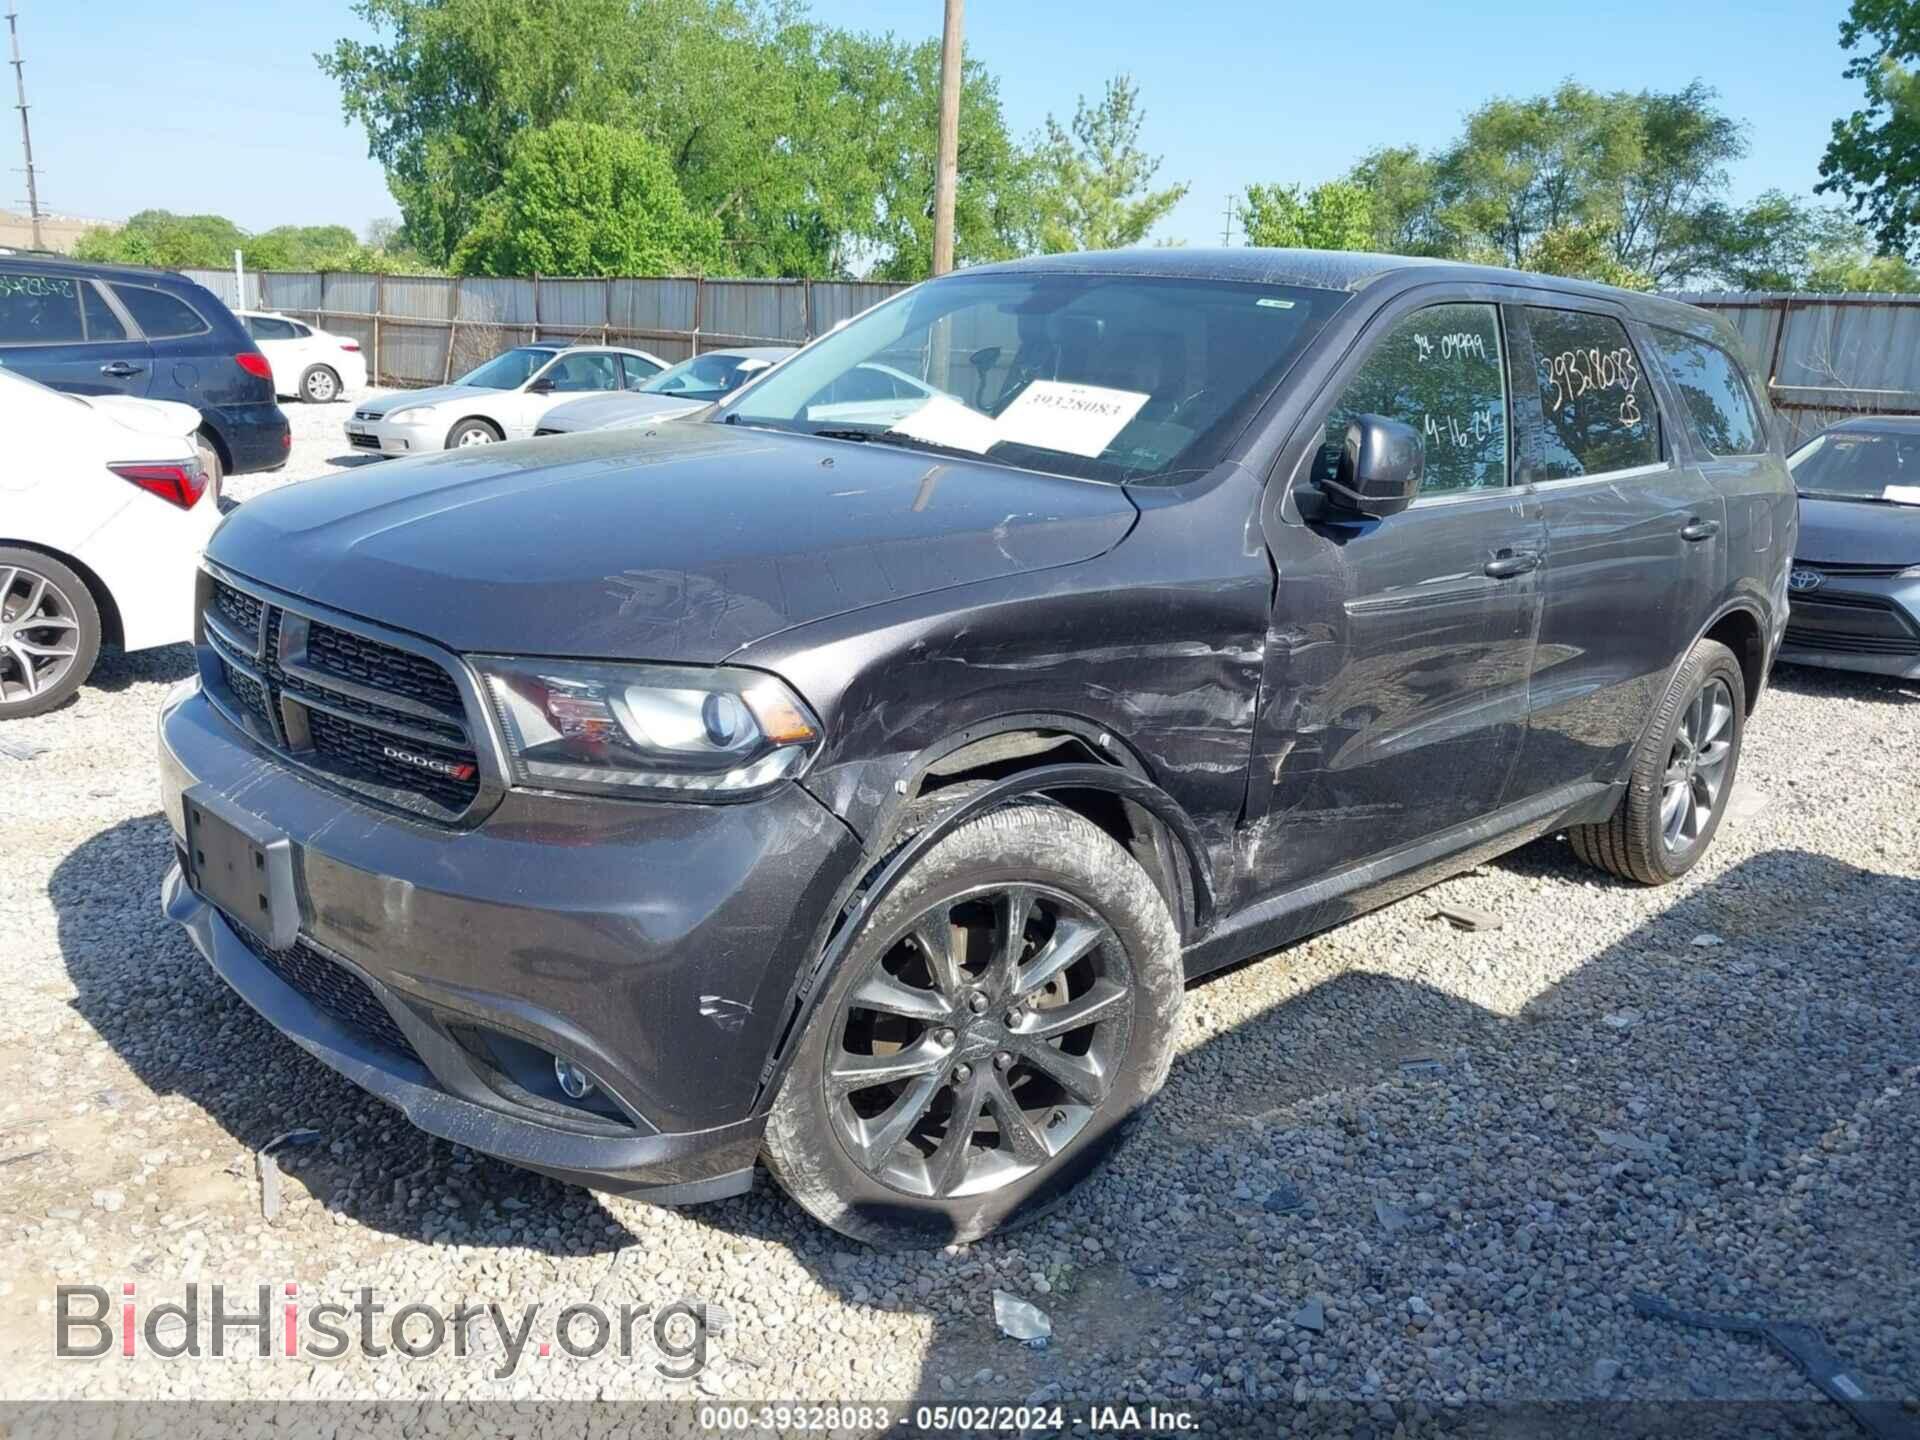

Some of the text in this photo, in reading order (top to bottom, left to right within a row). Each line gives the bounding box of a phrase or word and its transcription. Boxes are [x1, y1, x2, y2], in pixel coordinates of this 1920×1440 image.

[1540, 347, 1638, 412] 39328083
[1424, 409, 1493, 447] 4-16-24
[383, 746, 459, 776] DODGE
